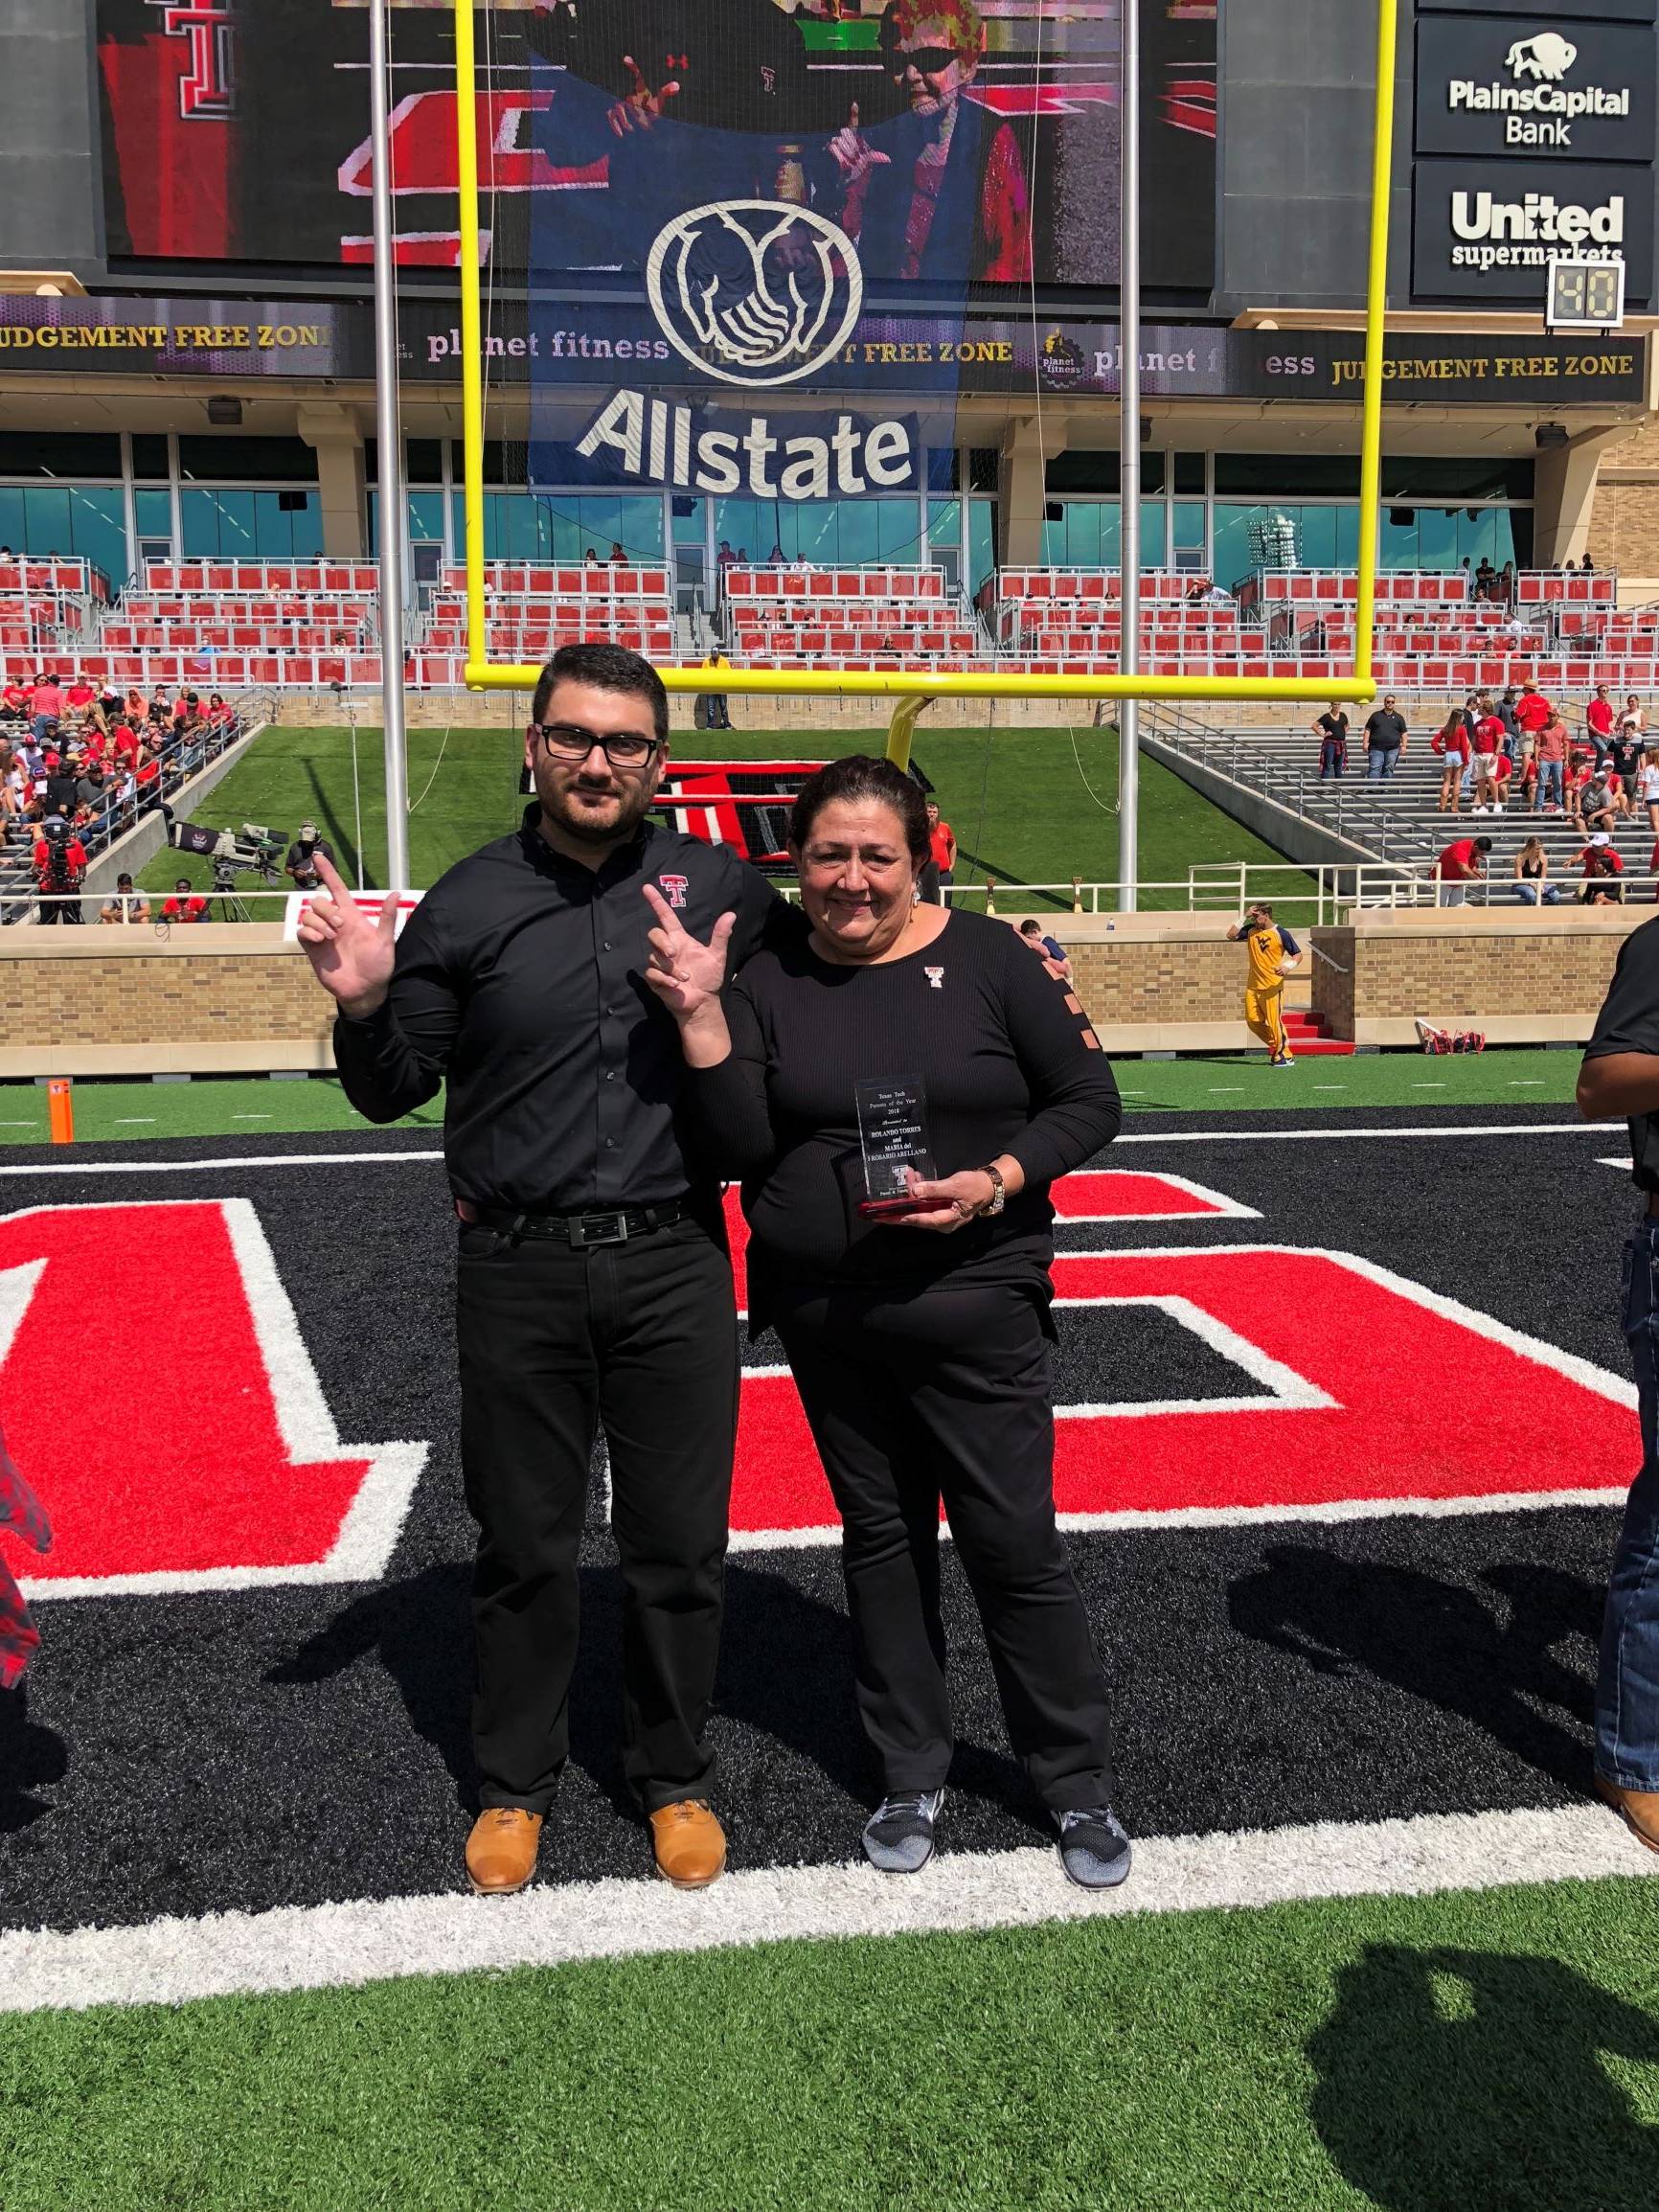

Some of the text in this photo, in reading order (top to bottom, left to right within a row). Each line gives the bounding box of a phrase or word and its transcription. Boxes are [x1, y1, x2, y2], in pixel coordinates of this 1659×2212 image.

[1449, 80, 1629, 117] PlainsCapital
[1506, 116, 1571, 147] Bank
[1451, 192, 1625, 242] United
[1451, 242, 1624, 271] supermarkets
[1557, 270, 1614, 318] 40
[174, 326, 250, 347] FREE
[427, 329, 539, 362] plnet
[552, 331, 670, 360] fitness
[865, 343, 932, 363] FREE
[939, 341, 1012, 362] ZONE
[1043, 356, 1074, 367] planet
[1094, 345, 1196, 377] plnet
[1494, 356, 1558, 377] FREE
[1564, 355, 1633, 376] ZONE
[1047, 364, 1080, 374] fitness
[577, 389, 915, 501] Allstate
[872, 1126, 921, 1138] ROLANDO TORRES
[872, 1152, 896, 1161] ROSARIO
[897, 1148, 926, 1158] ARELLANO
